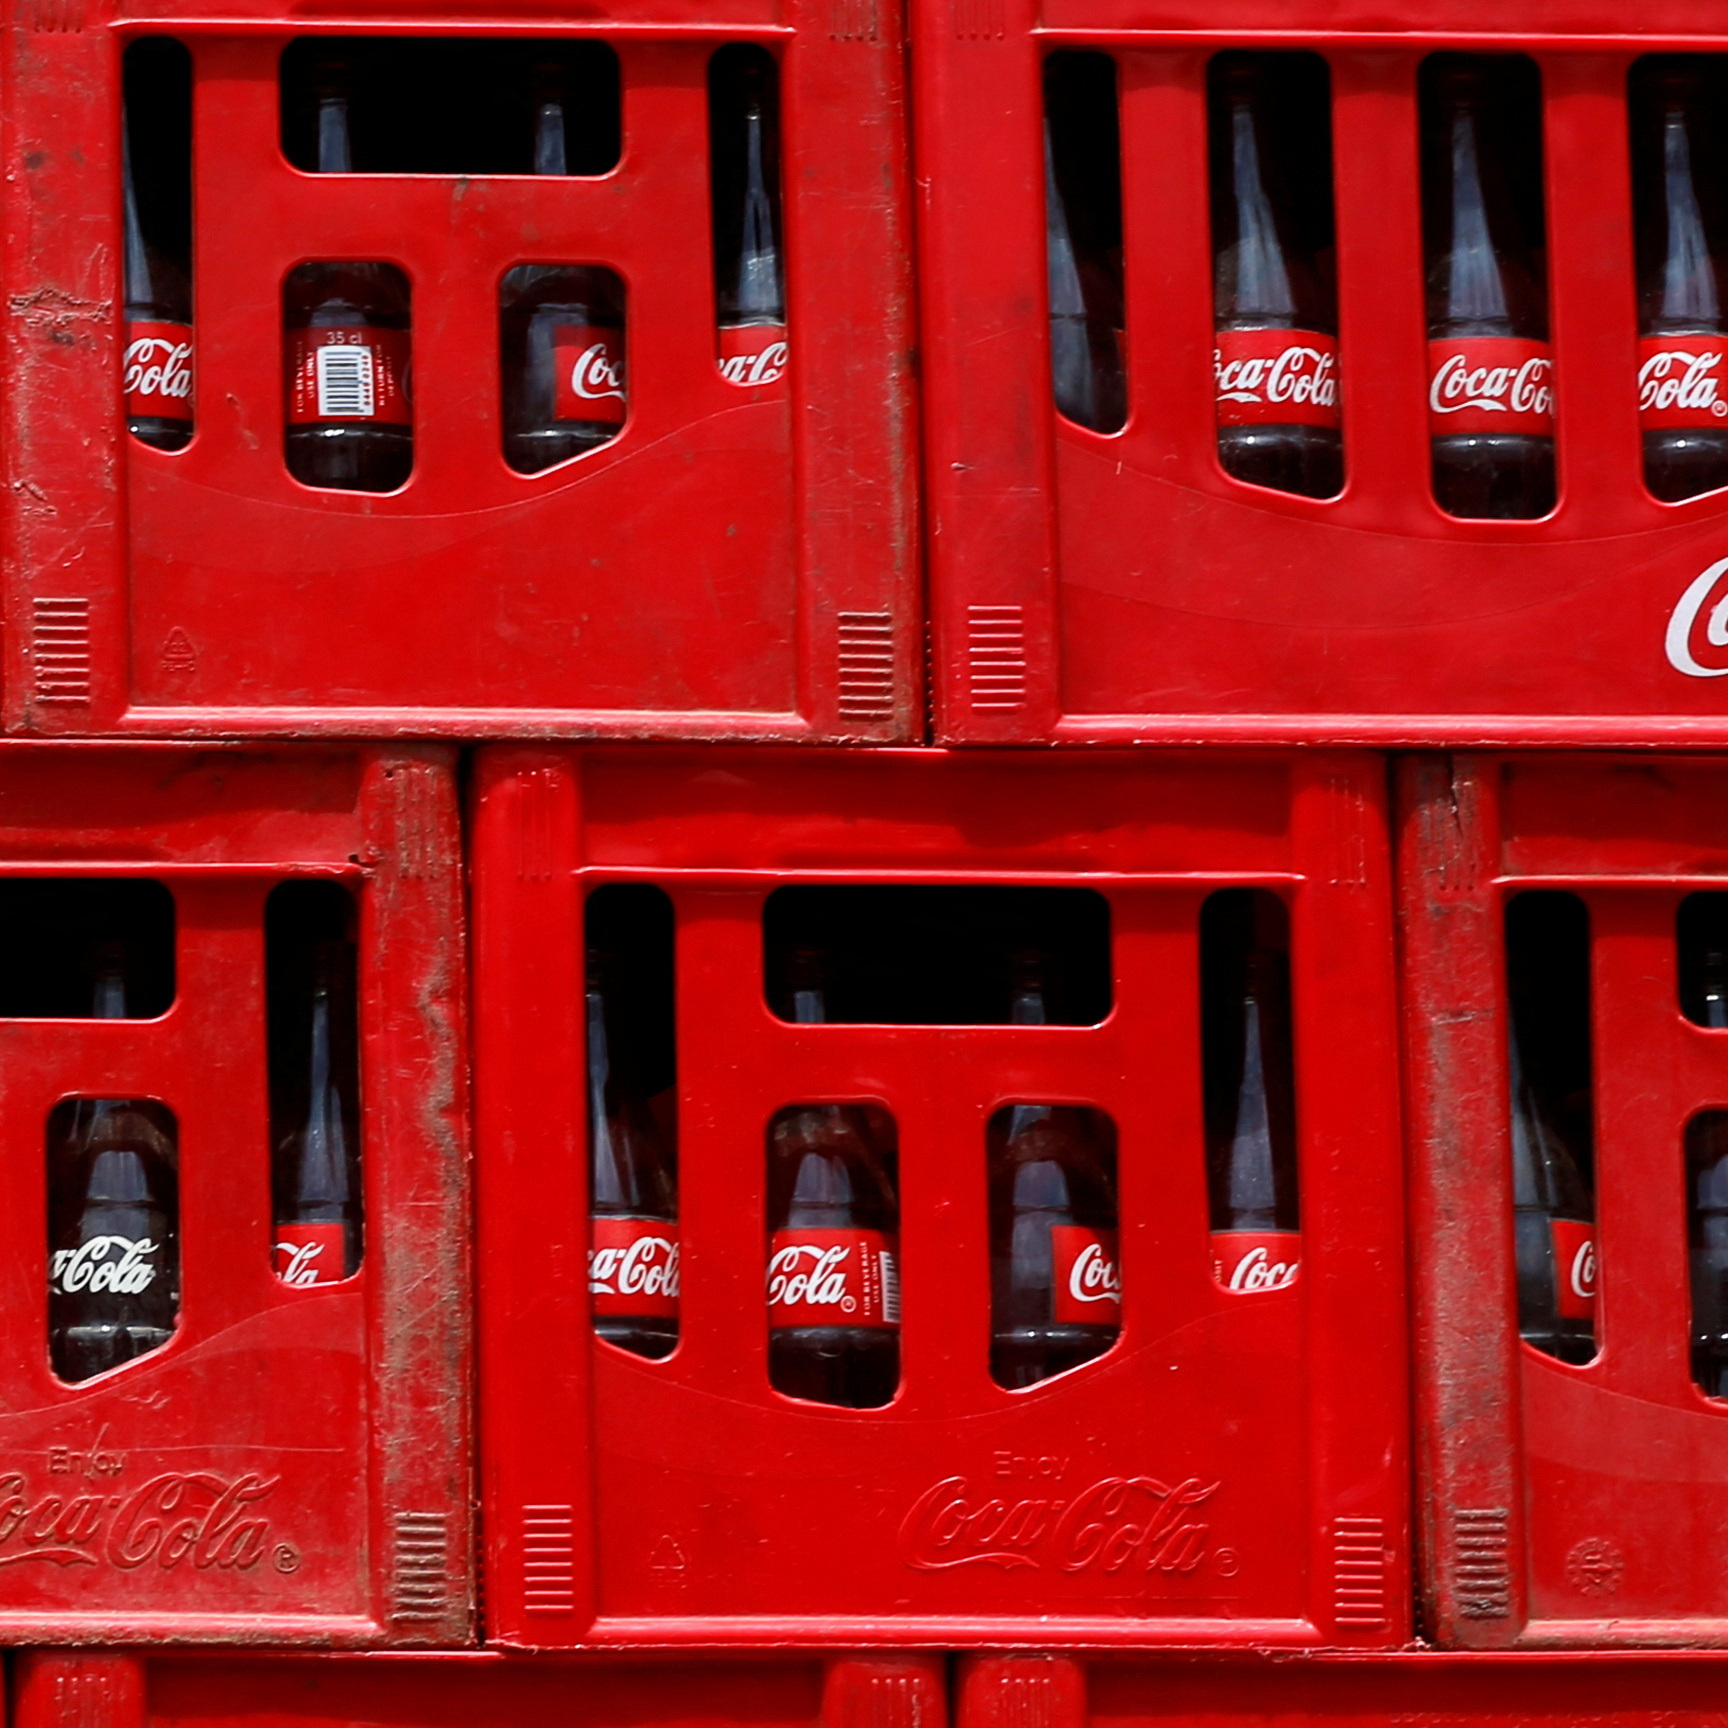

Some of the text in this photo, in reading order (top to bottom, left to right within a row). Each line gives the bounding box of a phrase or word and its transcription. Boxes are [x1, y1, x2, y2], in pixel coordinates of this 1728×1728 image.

[325, 331, 363, 345] 35 cl
[897, 1474, 1223, 1572] Coca-Cola
